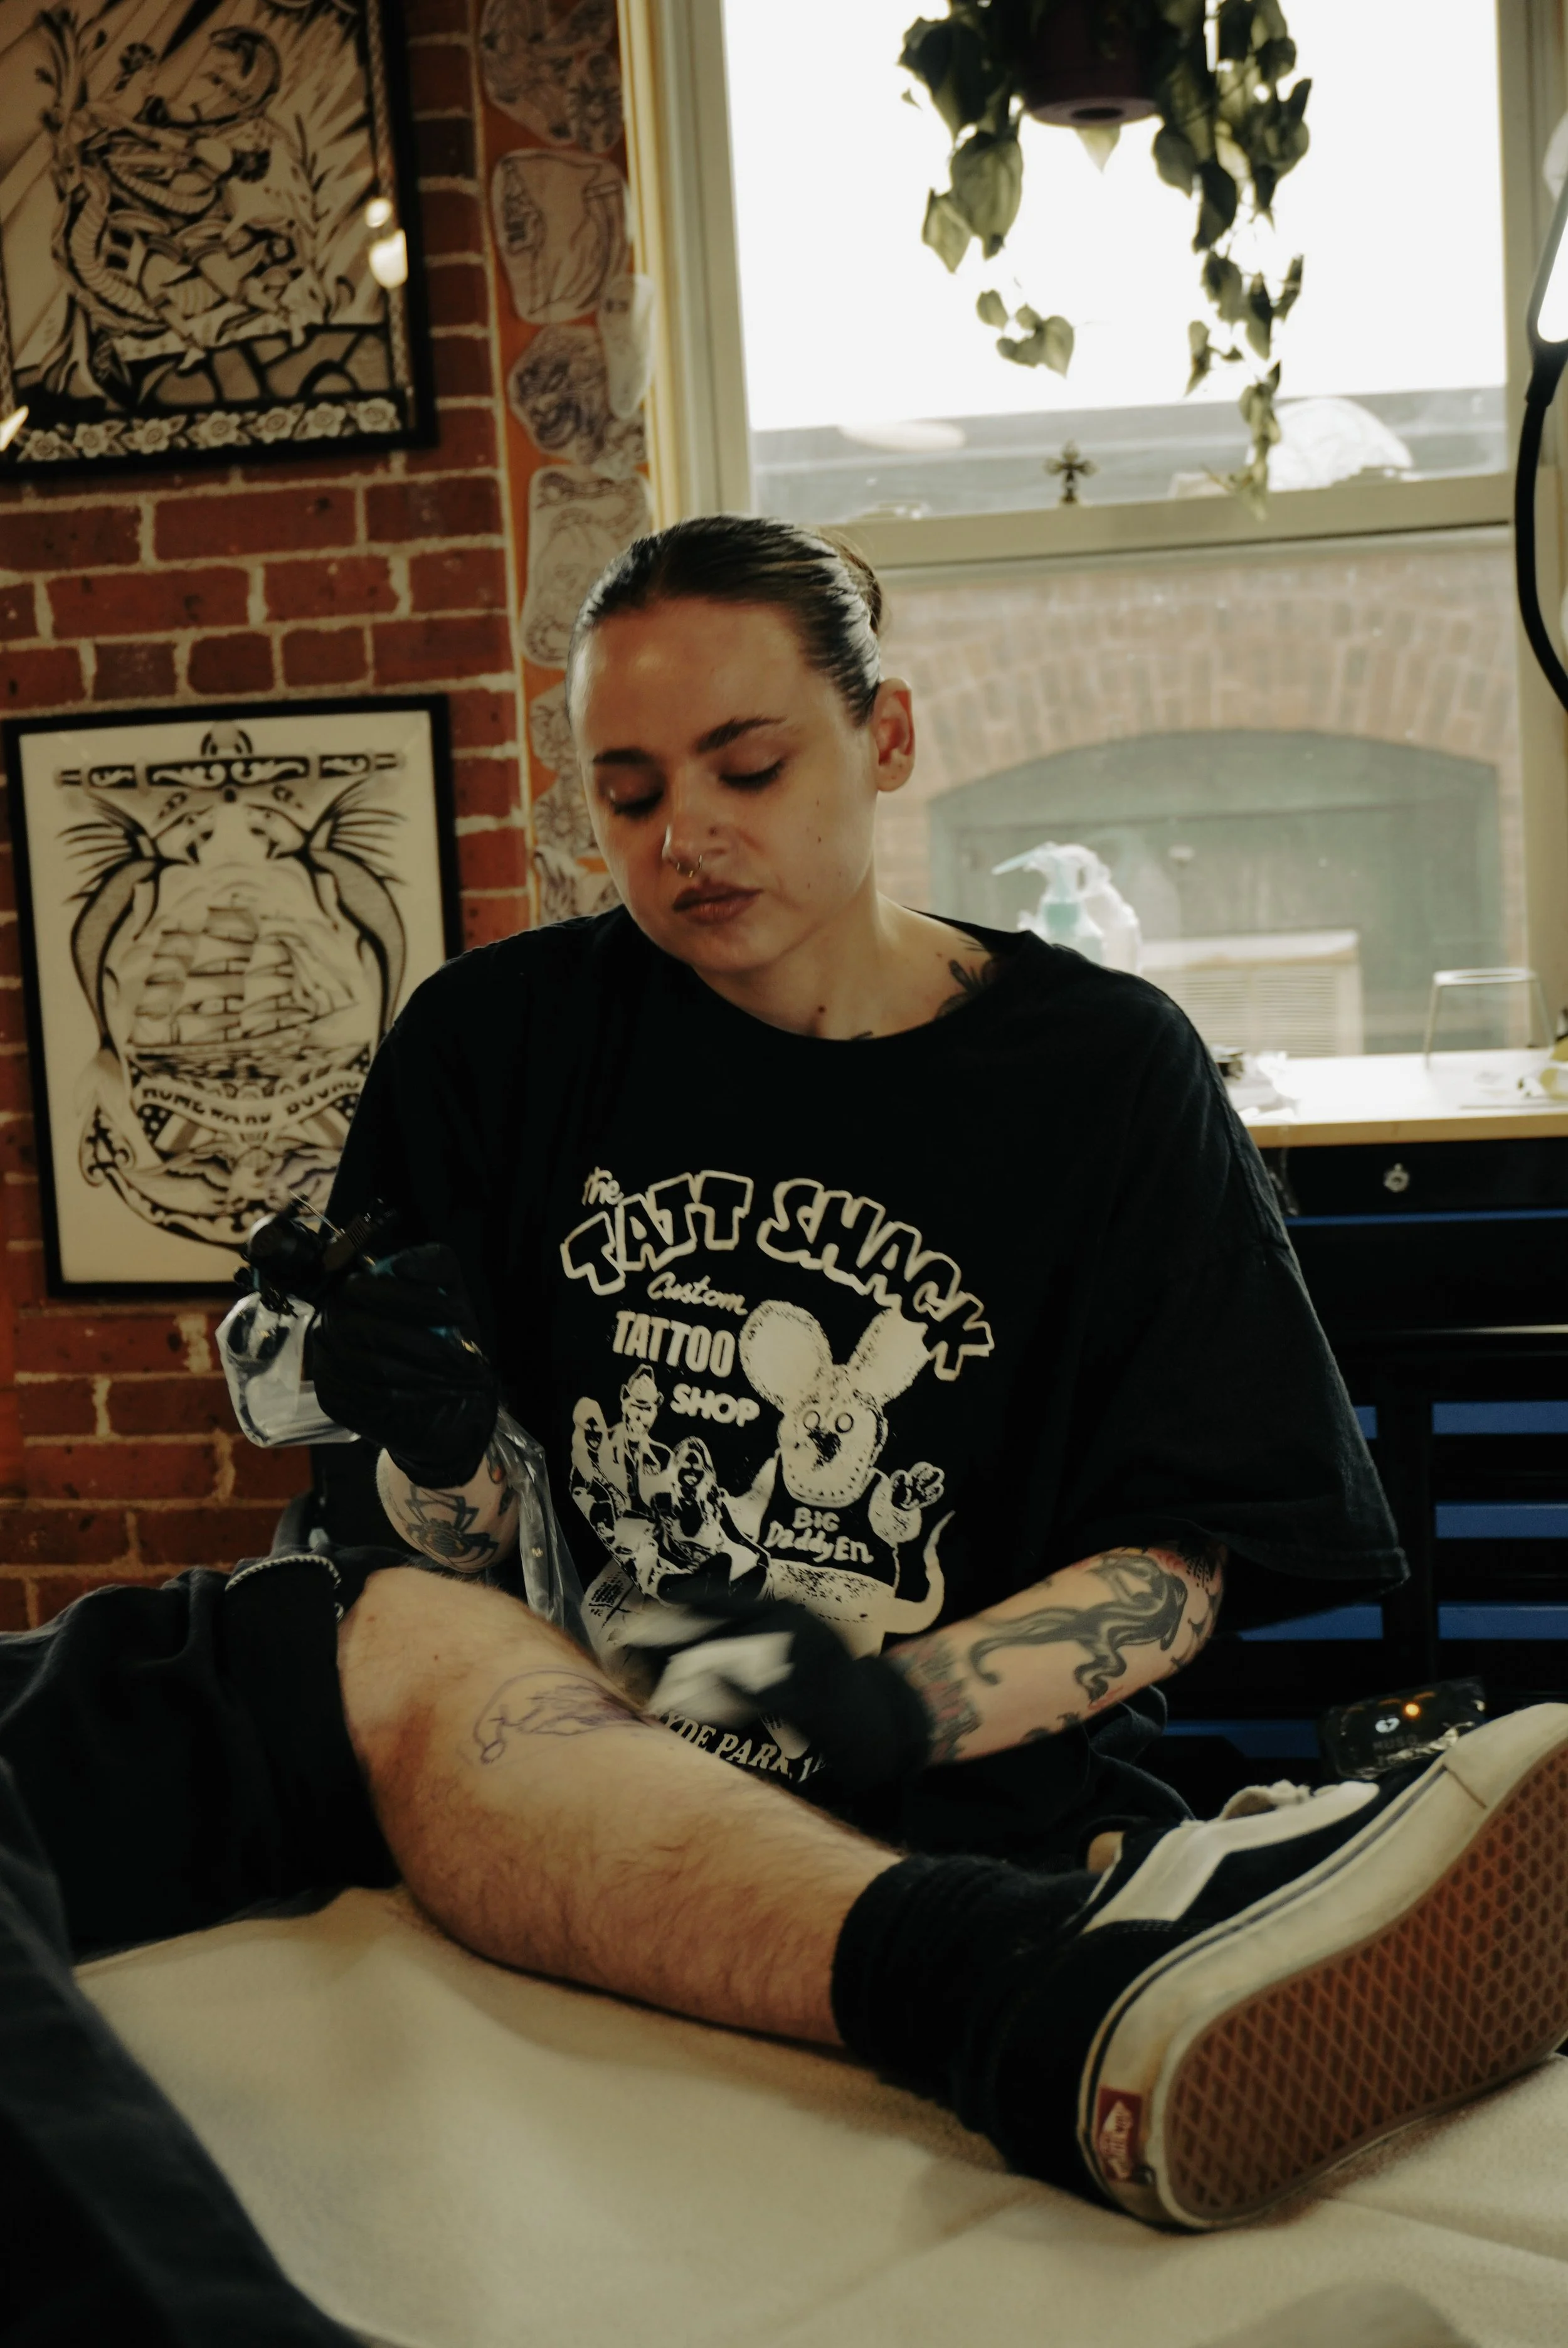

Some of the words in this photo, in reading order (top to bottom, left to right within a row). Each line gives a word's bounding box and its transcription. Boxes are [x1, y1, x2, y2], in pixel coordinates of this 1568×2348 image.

[581, 1166, 625, 1206] The
[560, 1169, 753, 1295] TATT
[756, 1177, 995, 1381] SHACK
[647, 1271, 749, 1316] Custom
[612, 1310, 736, 1378] TATTOO
[669, 1383, 761, 1428] SHOP
[661, 1710, 718, 1751] YDE
